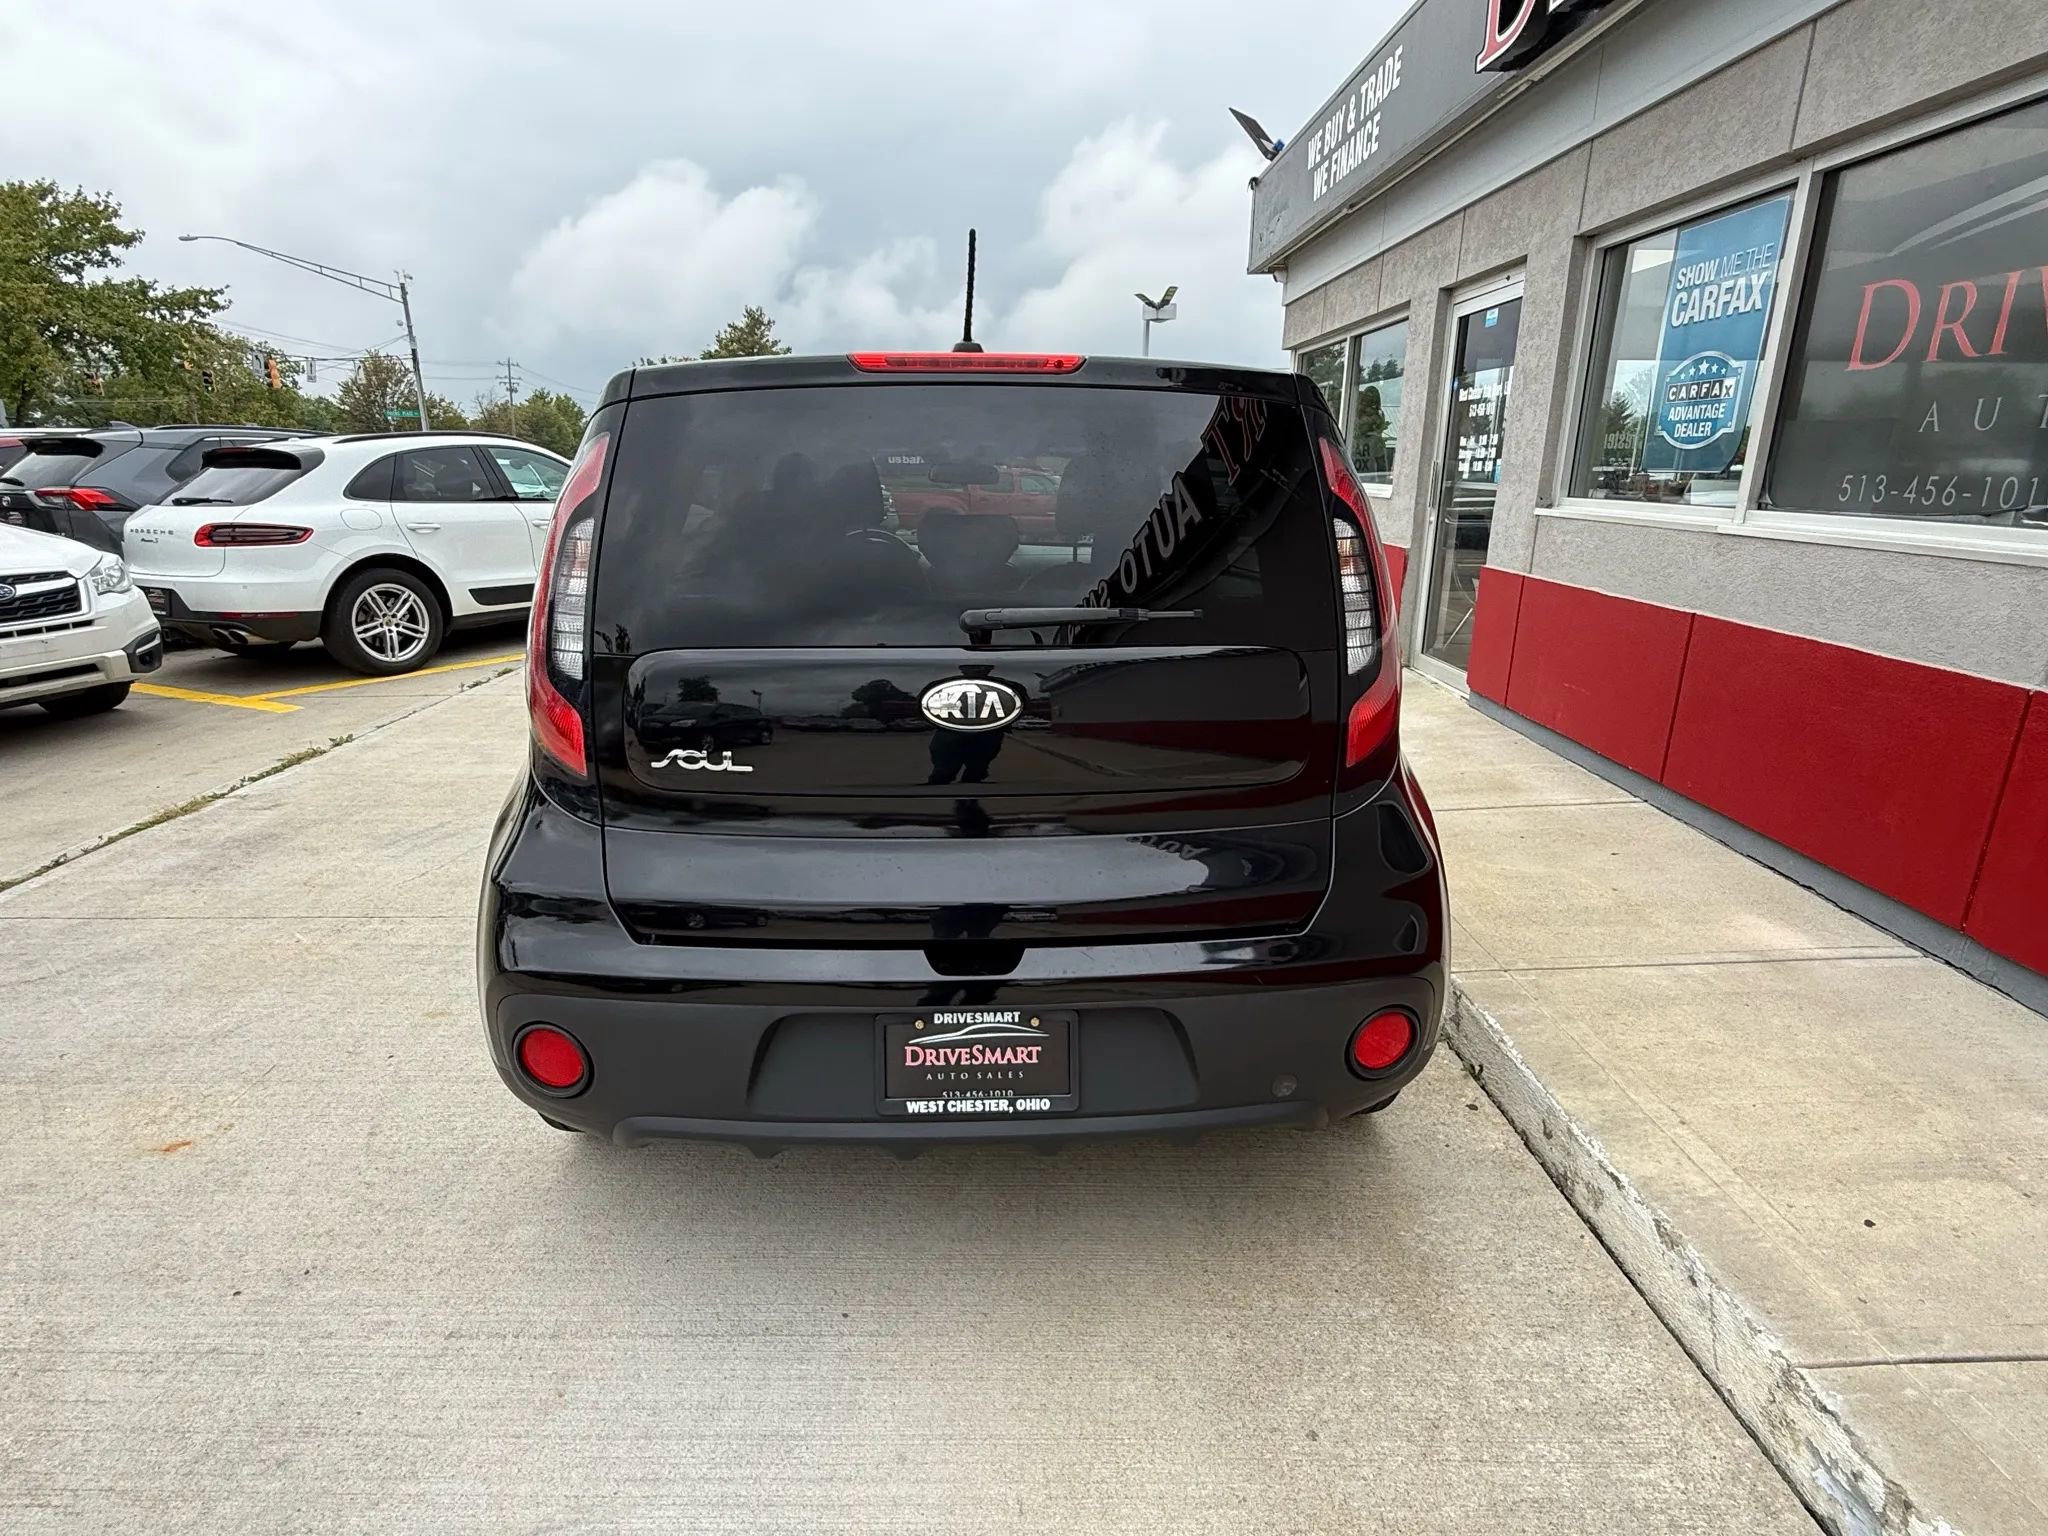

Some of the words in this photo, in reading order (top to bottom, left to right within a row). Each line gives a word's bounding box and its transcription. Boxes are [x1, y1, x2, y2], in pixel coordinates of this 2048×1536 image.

[1307, 129, 1323, 171] WE
[1323, 104, 1346, 156] BUY
[1347, 93, 1357, 134] &
[1360, 44, 1404, 122] TRADE
[1313, 159, 1330, 202] WE
[1330, 111, 1382, 188] FINANCE
[1676, 258, 1720, 290] SHOW
[1720, 251, 1745, 278] ME
[1745, 242, 1776, 273] THE
[1671, 270, 1769, 328] CARFAX
[1844, 265, 2048, 372] DRI
[1668, 382, 1733, 401] CARFAX
[1668, 403, 1726, 421] ADVANTAGE
[1674, 422, 1712, 438] DEALER
[1838, 474, 2039, 508] 513-456-101
[939, 690, 1006, 719] KIA
[650, 748, 754, 772] SOUL
[933, 1011, 1021, 1025] DRIVESMART
[926, 1072, 969, 1081] AUTO
[977, 1071, 1024, 1080] SALES
[906, 1100, 945, 1113] WEST
[947, 1099, 1013, 1114] CHESTER,
[1016, 1098, 1051, 1111] OHIO
[942, 1089, 1014, 1099] 513-456-1010
